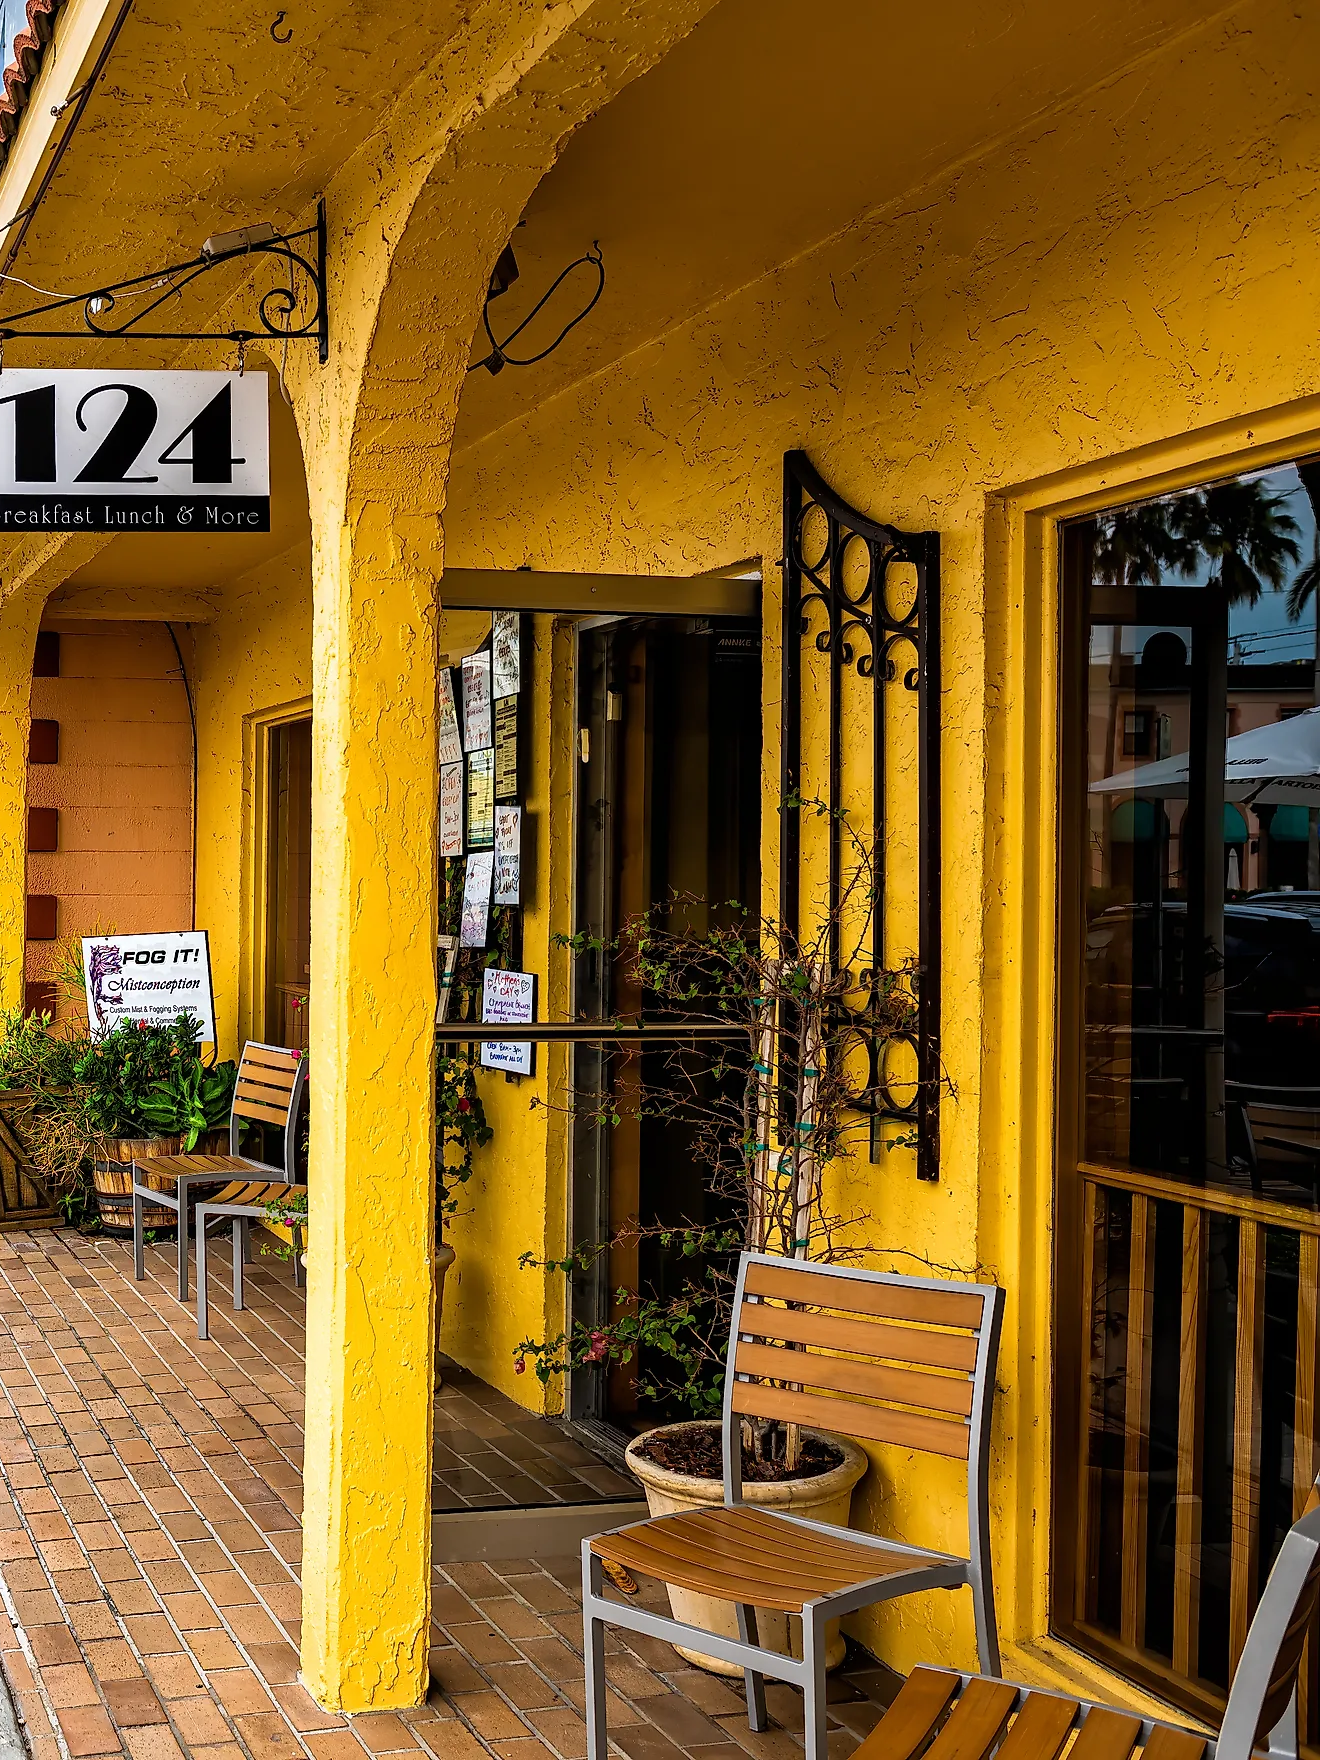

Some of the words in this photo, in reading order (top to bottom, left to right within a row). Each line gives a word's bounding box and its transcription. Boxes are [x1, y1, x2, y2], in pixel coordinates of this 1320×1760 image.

[105, 505, 165, 525] Lunch
[177, 505, 194, 525] &
[206, 506, 260, 525] More
[122, 949, 167, 965] FOG
[173, 948, 200, 963] IT!
[108, 978, 201, 994] Mistconception
[109, 1005, 131, 1014] Custom
[144, 1005, 148, 1013] &
[149, 1005, 172, 1015] Fogging
[173, 1004, 198, 1013] Systems
